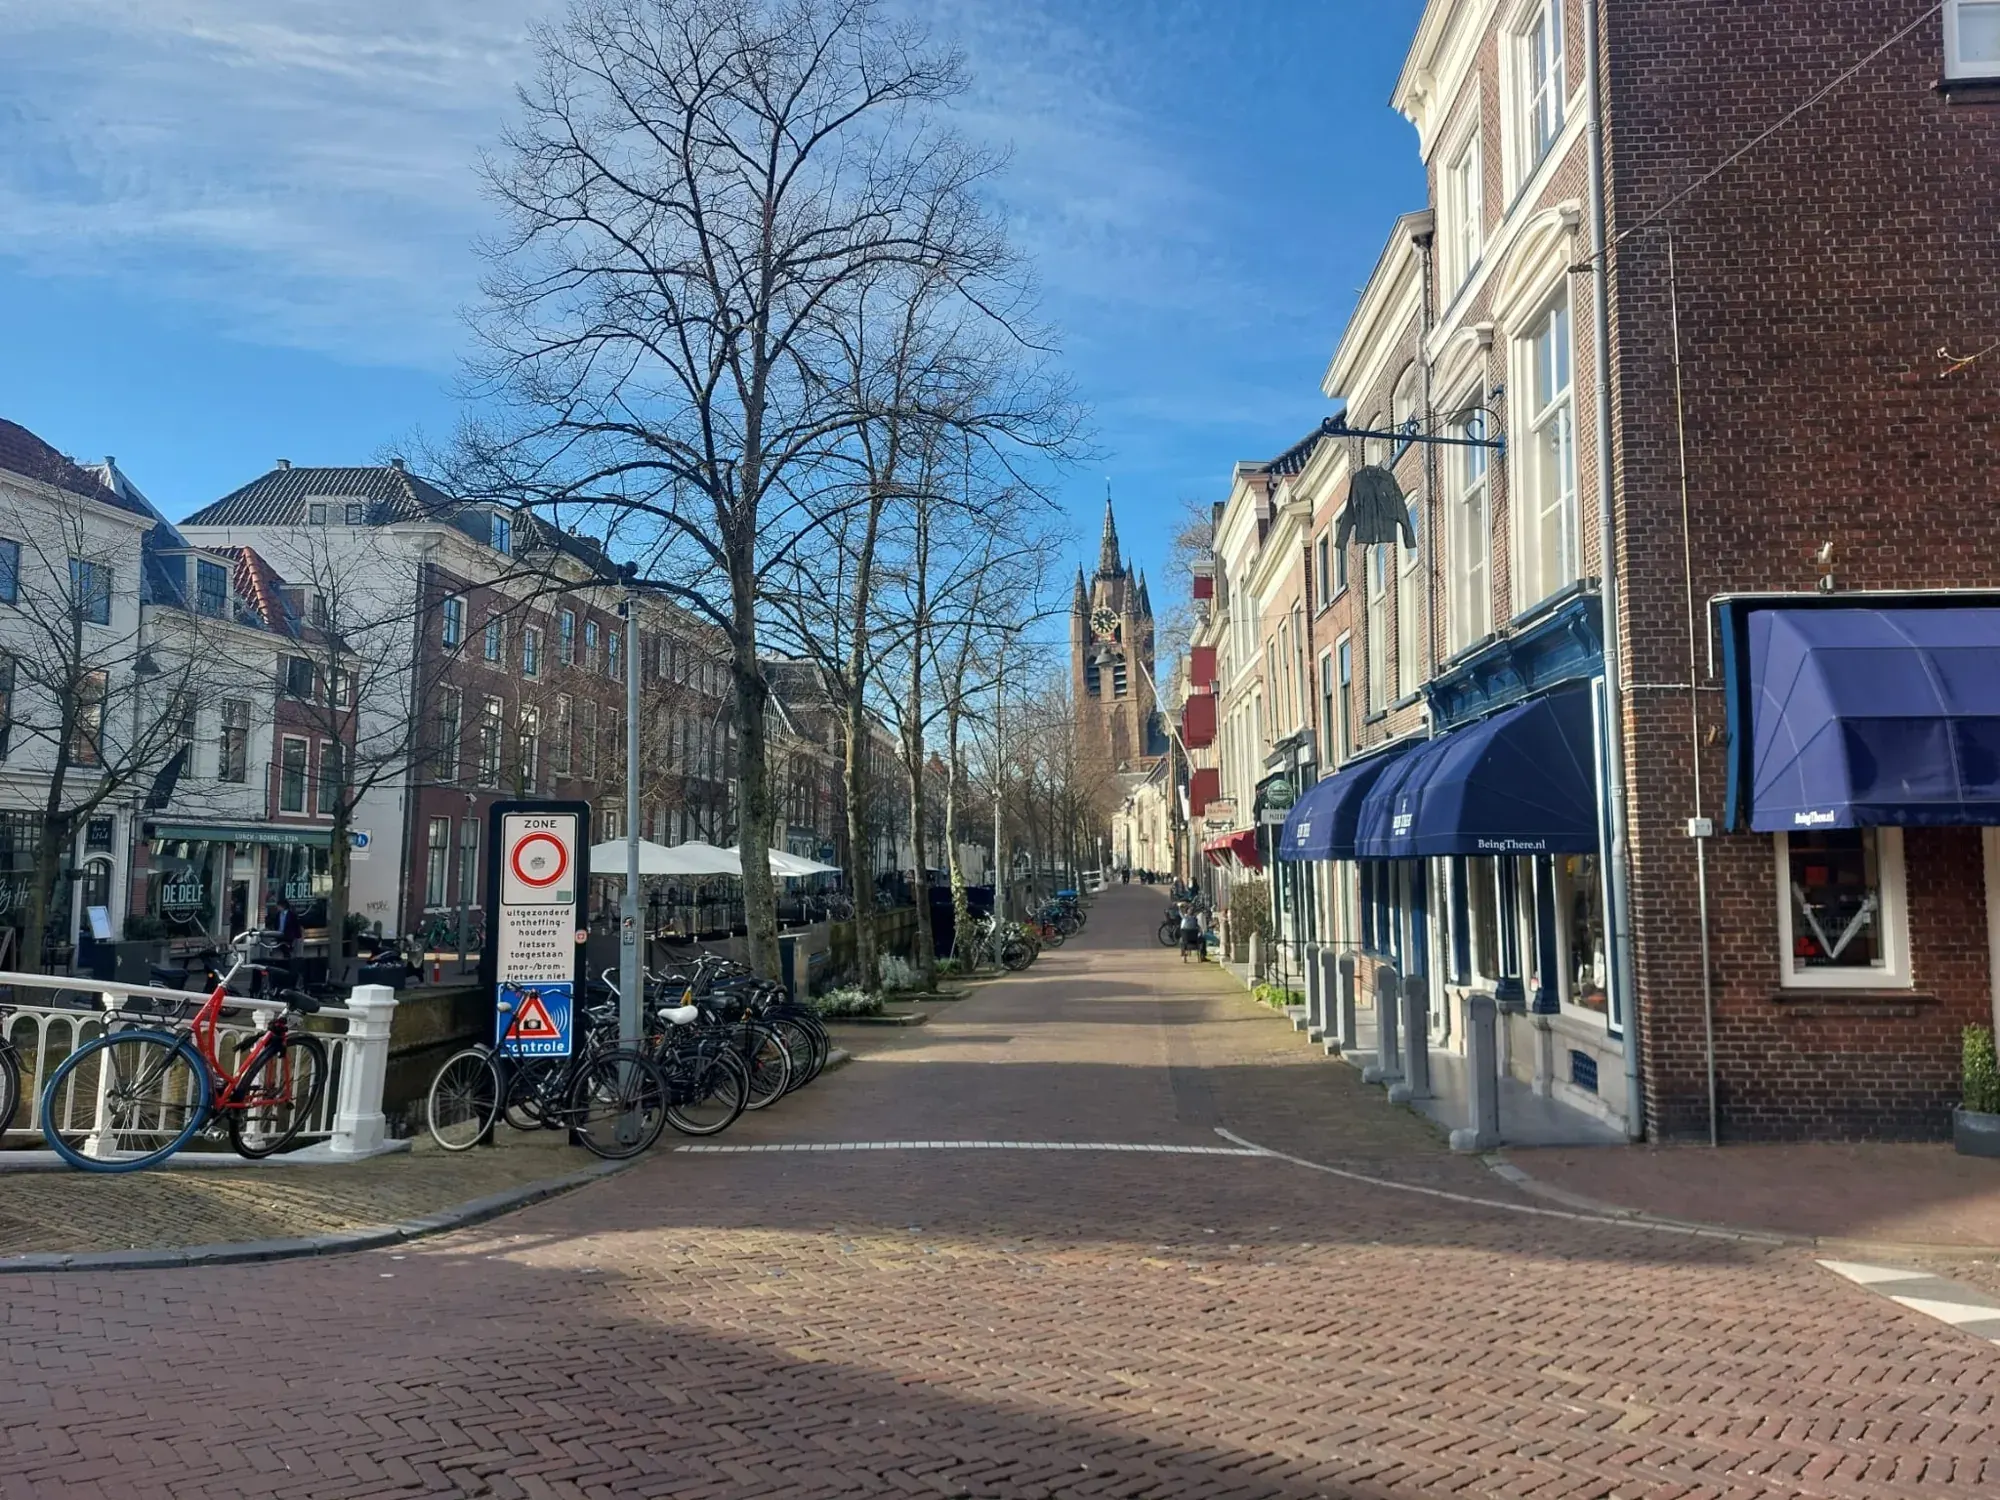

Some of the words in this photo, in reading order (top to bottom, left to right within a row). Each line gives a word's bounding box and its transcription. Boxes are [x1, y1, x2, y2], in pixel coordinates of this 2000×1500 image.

[524, 819, 557, 829] ZONE
[1477, 839, 1546, 851] BeingThere.nl
[162, 884, 177, 903] DE
[178, 884, 204, 902] DELF
[285, 882, 296, 899] DE
[506, 909, 570, 918] uitgezonderd
[510, 919, 566, 928] ontheffing-
[510, 951, 564, 959] toegestaan
[507, 963, 565, 971] snor-/brom-
